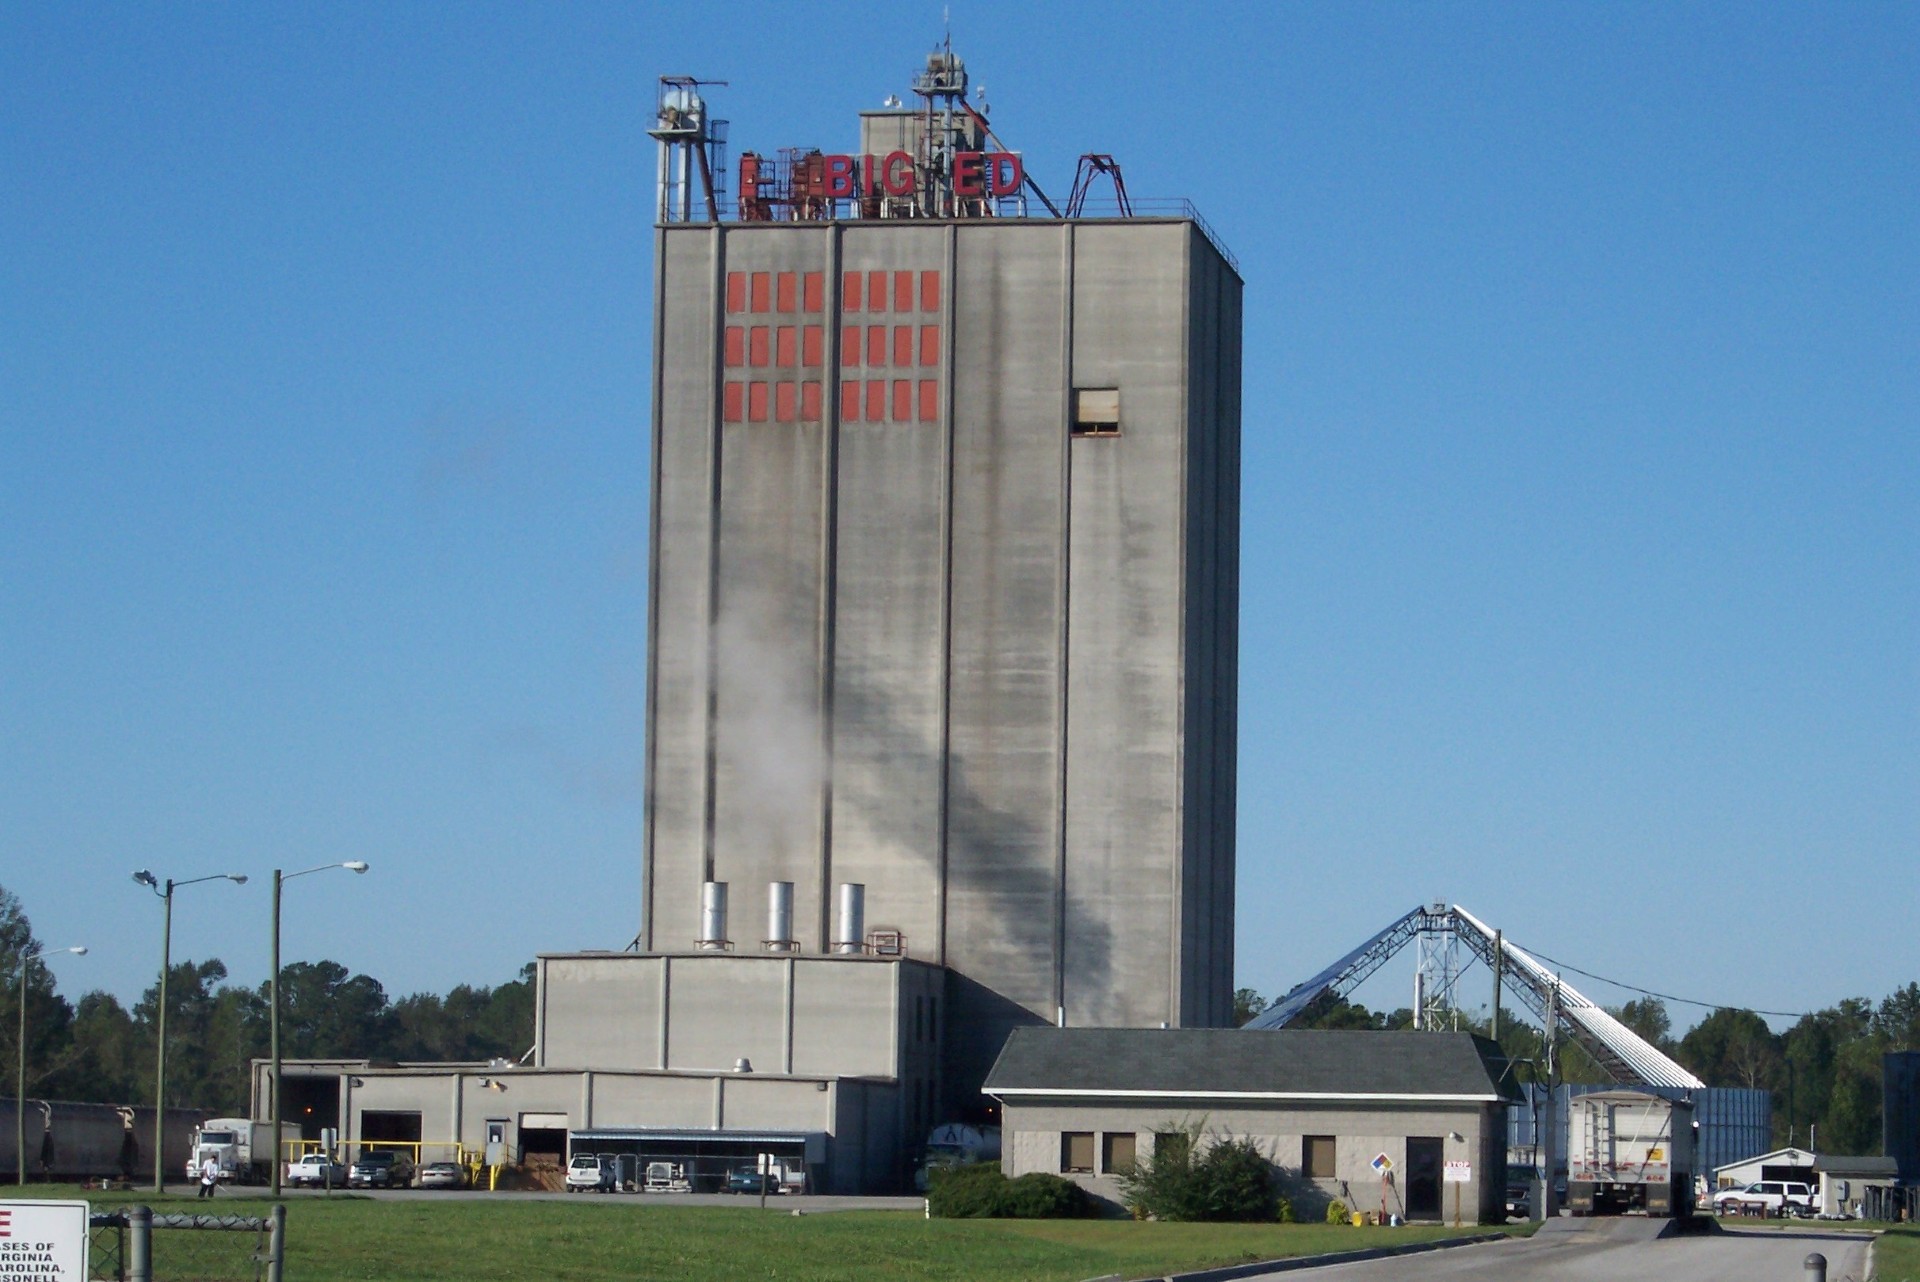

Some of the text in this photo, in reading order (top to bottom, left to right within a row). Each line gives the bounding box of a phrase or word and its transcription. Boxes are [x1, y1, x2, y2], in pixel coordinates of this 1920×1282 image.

[824, 150, 1022, 198] BIG ED
[0, 1242, 55, 1251] SES OF
[0, 1274, 59, 1282] SONELL
